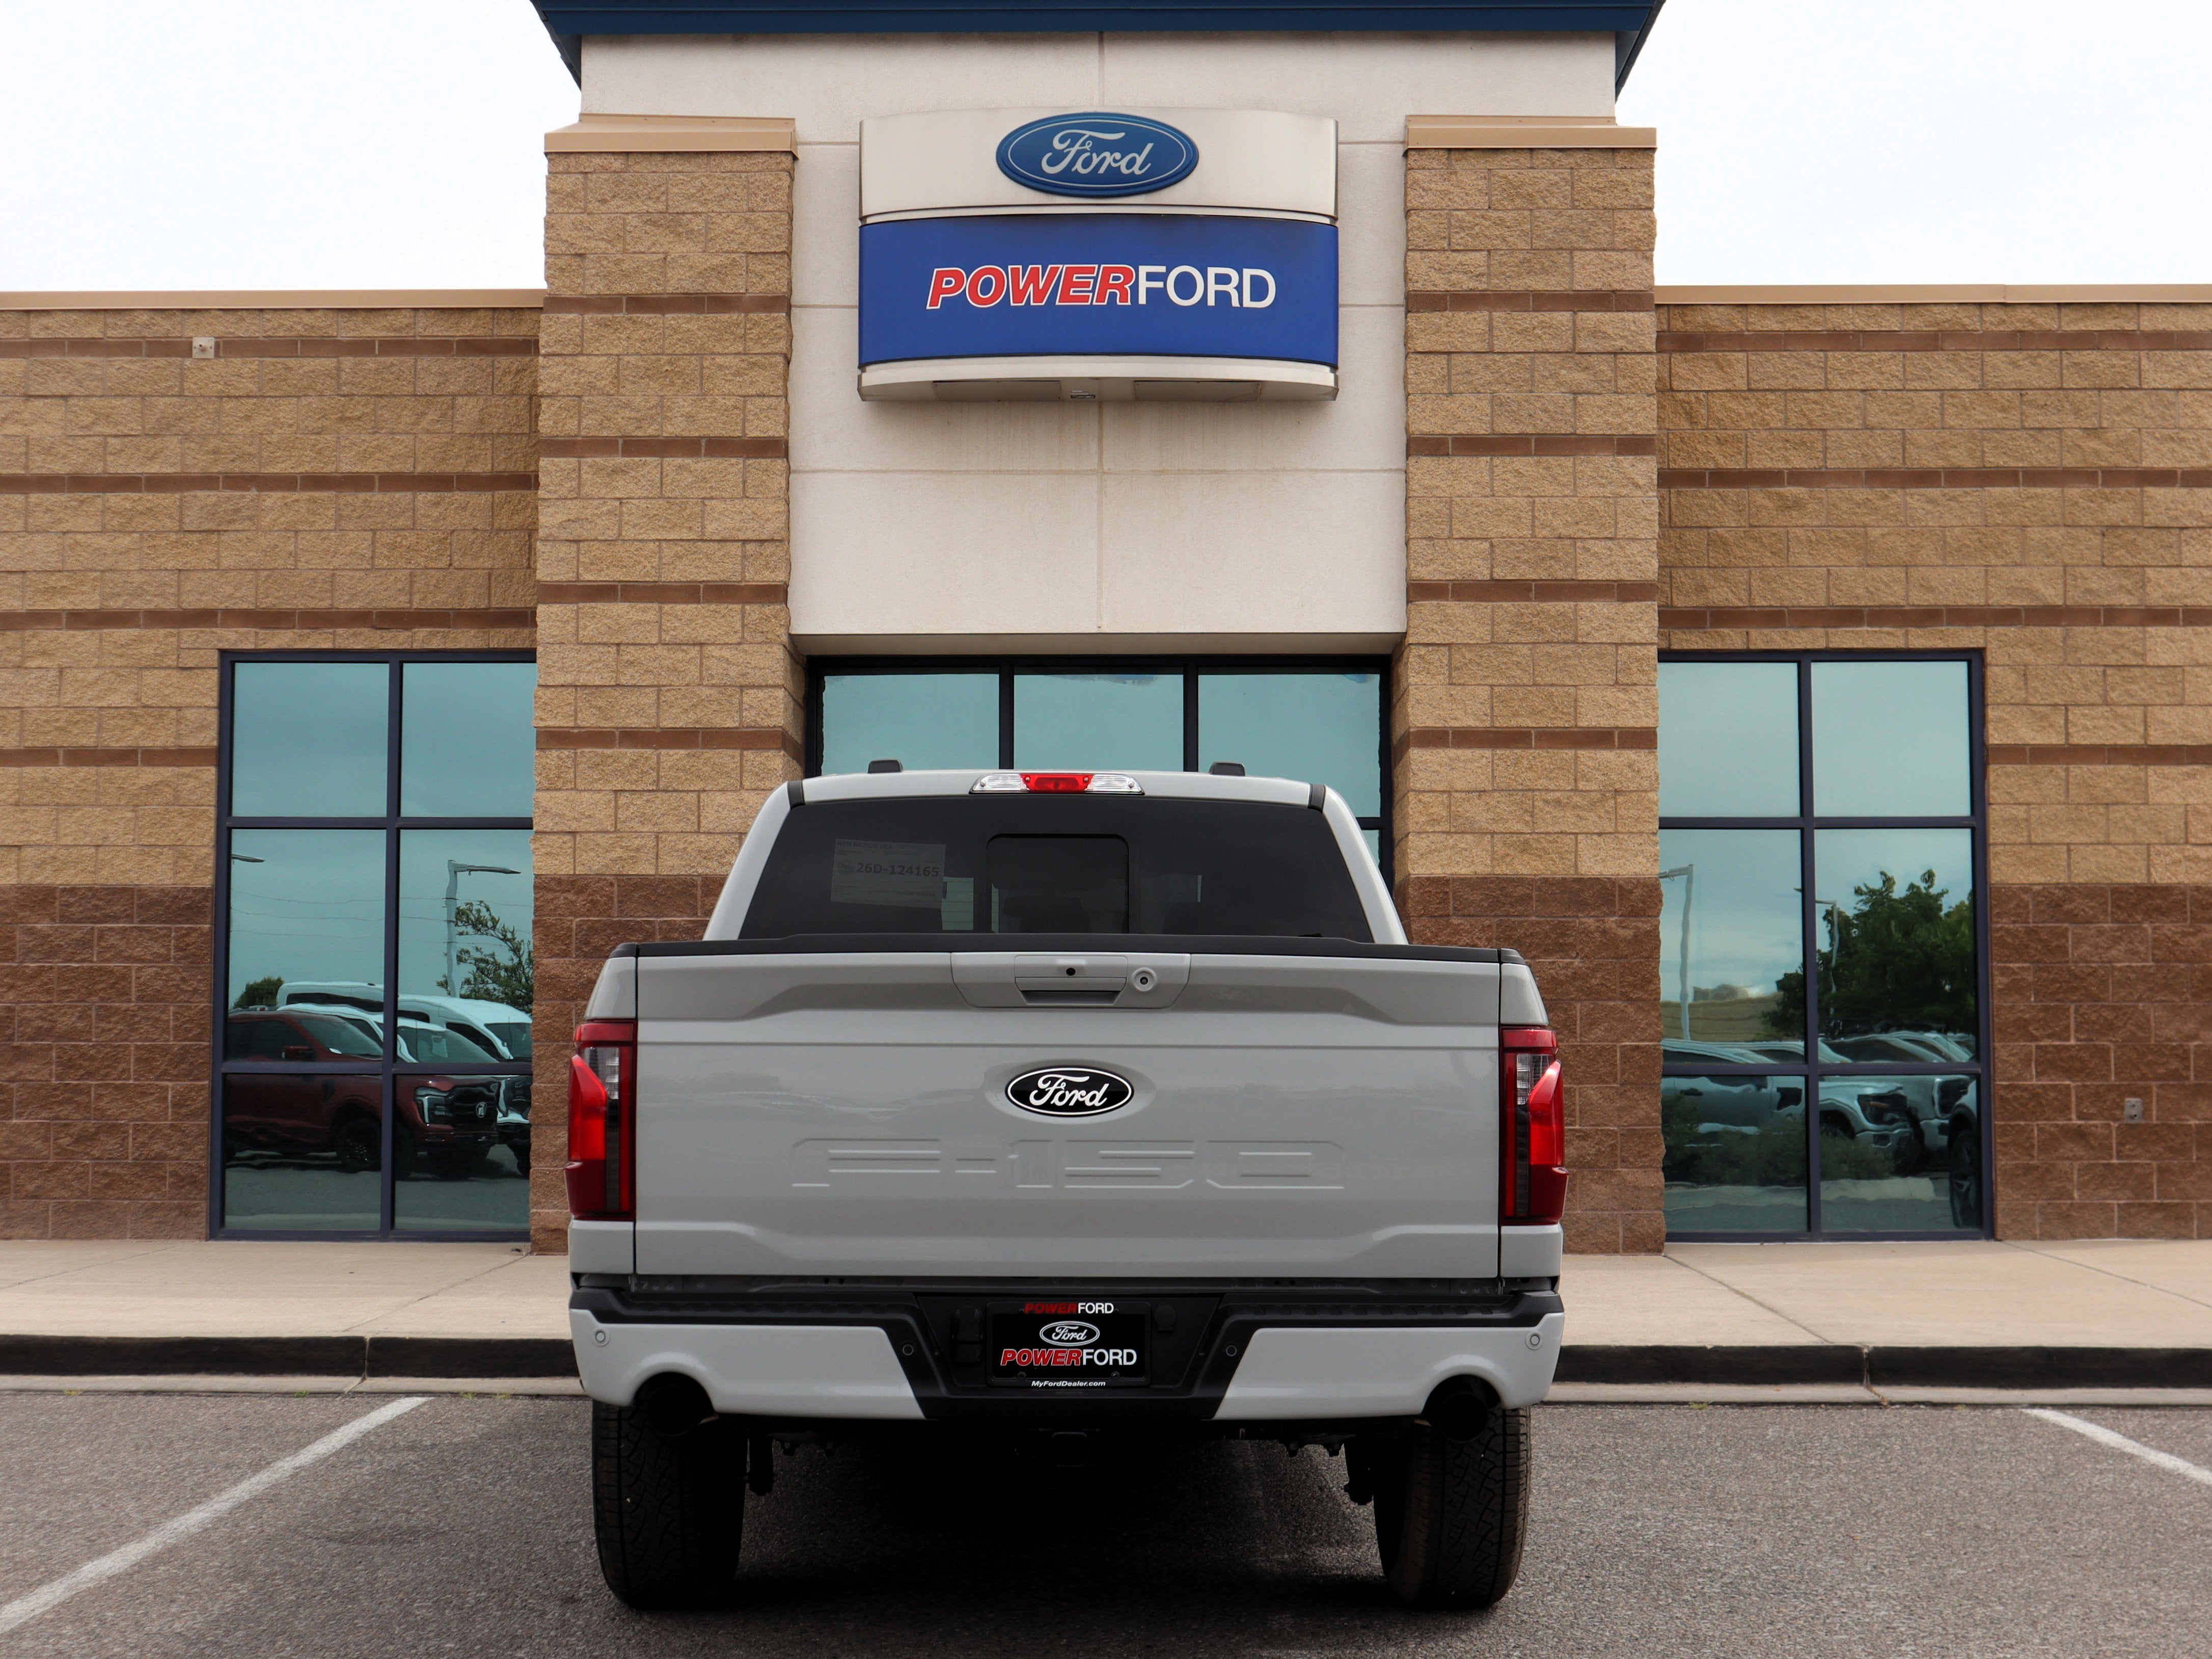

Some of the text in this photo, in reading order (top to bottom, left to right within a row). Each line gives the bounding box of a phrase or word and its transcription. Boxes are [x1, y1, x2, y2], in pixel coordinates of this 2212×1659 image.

[1041, 128, 1153, 176] Ford
[926, 264, 1276, 310] POWERFORD
[856, 862, 939, 877] 26D-124165
[1029, 1073, 1109, 1108] Ford
[1024, 1302, 1114, 1314] POWERFORD
[1052, 1325, 1087, 1341] Ford
[1000, 1348, 1137, 1366] POWERFORD
